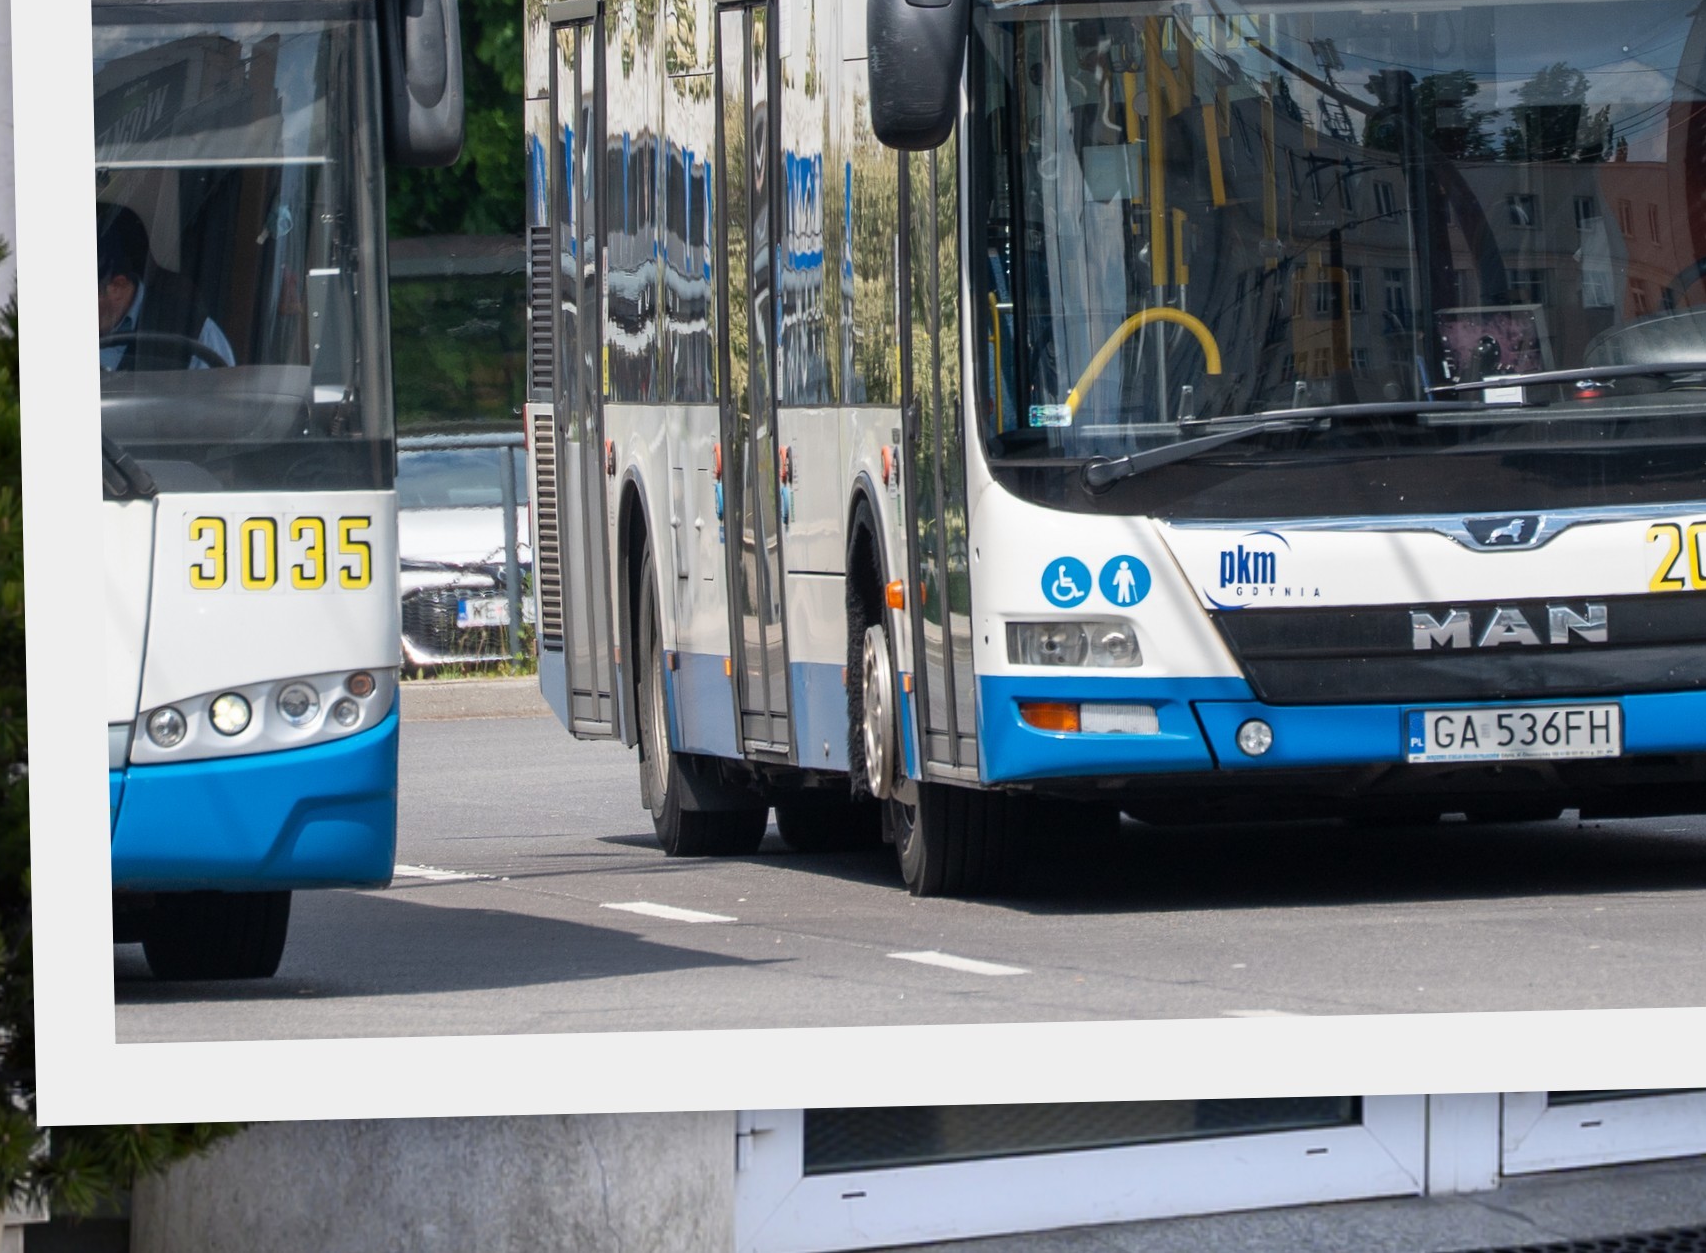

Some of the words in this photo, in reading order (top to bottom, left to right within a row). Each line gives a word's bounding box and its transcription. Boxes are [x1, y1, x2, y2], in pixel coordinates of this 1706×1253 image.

[189, 516, 372, 590] 3035
[1220, 544, 1276, 588] pkm
[1236, 586, 1320, 597] GDYNIA
[1409, 603, 1608, 650] MAN
[1411, 738, 1424, 747] PL
[1434, 715, 1479, 749] GA
[1497, 709, 1611, 747] 536FH
